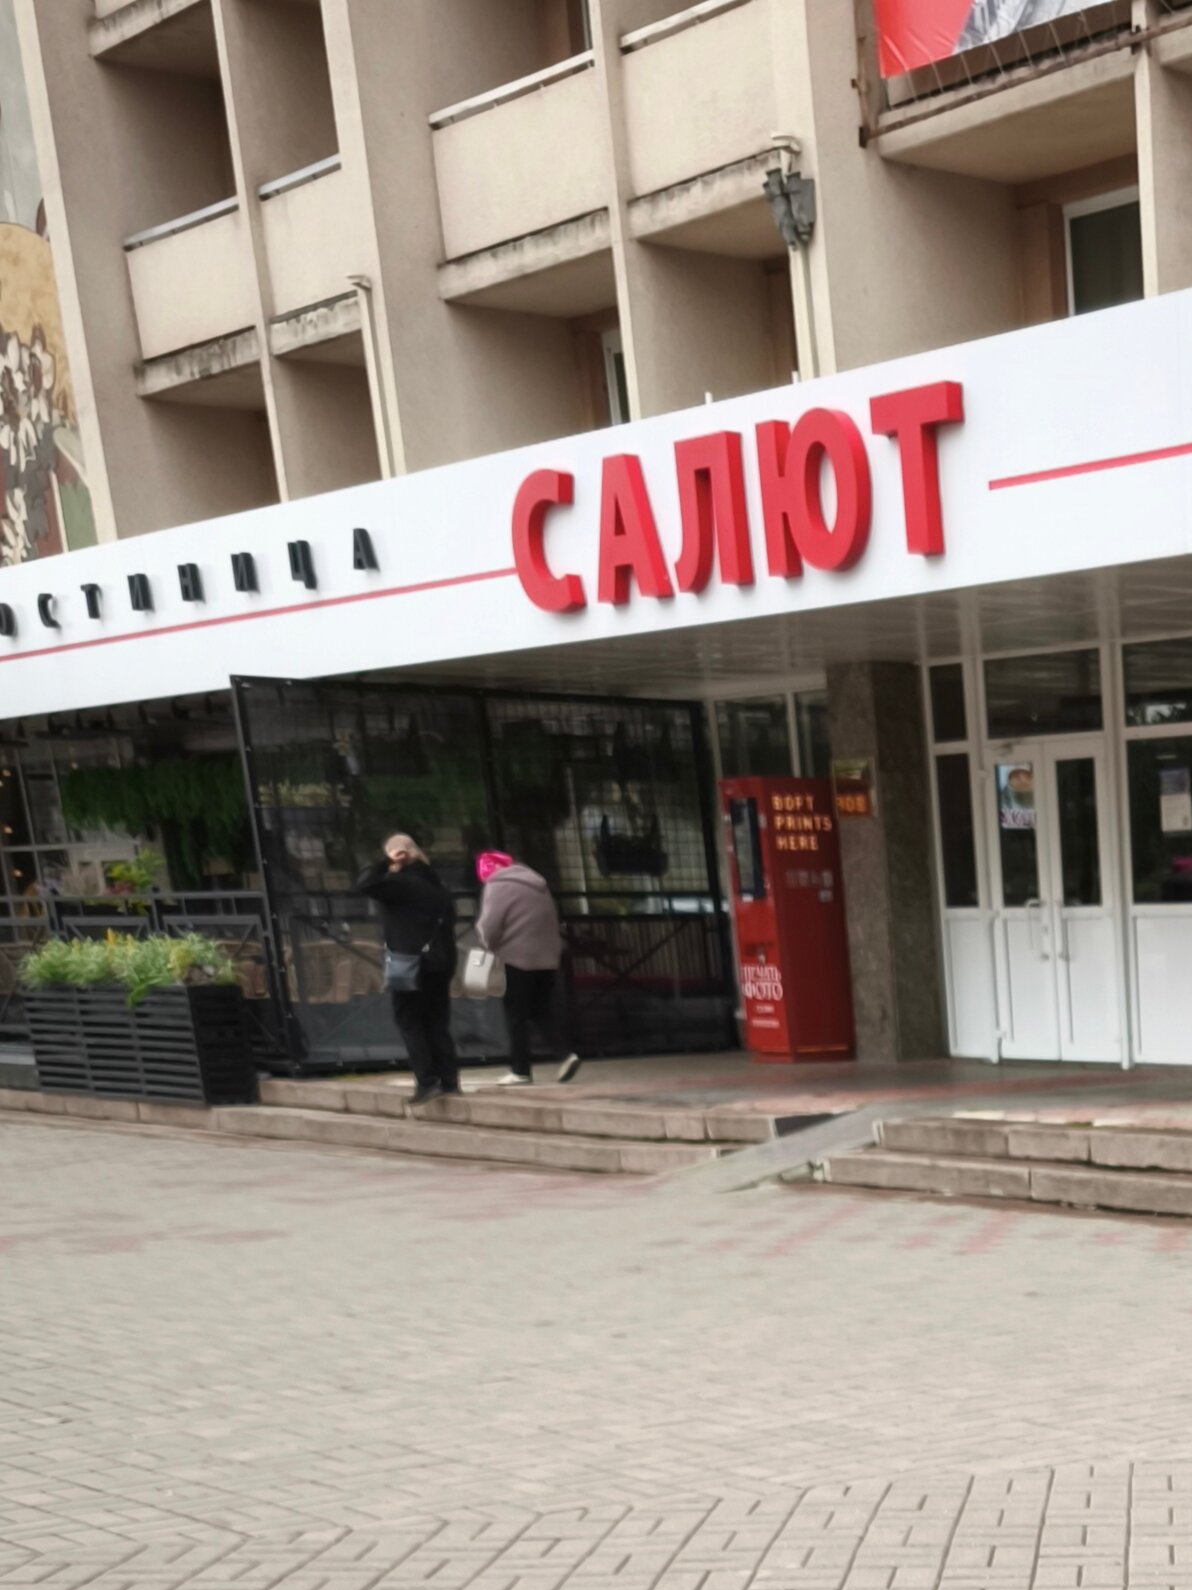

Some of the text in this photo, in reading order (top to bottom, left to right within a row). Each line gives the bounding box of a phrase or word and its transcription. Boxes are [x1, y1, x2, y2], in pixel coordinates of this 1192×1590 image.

[511, 380, 963, 614] САЛЮТ
[774, 815, 832, 831] PRINTS
[776, 836, 818, 850] HERE
[741, 980, 783, 1001] ФОТО
